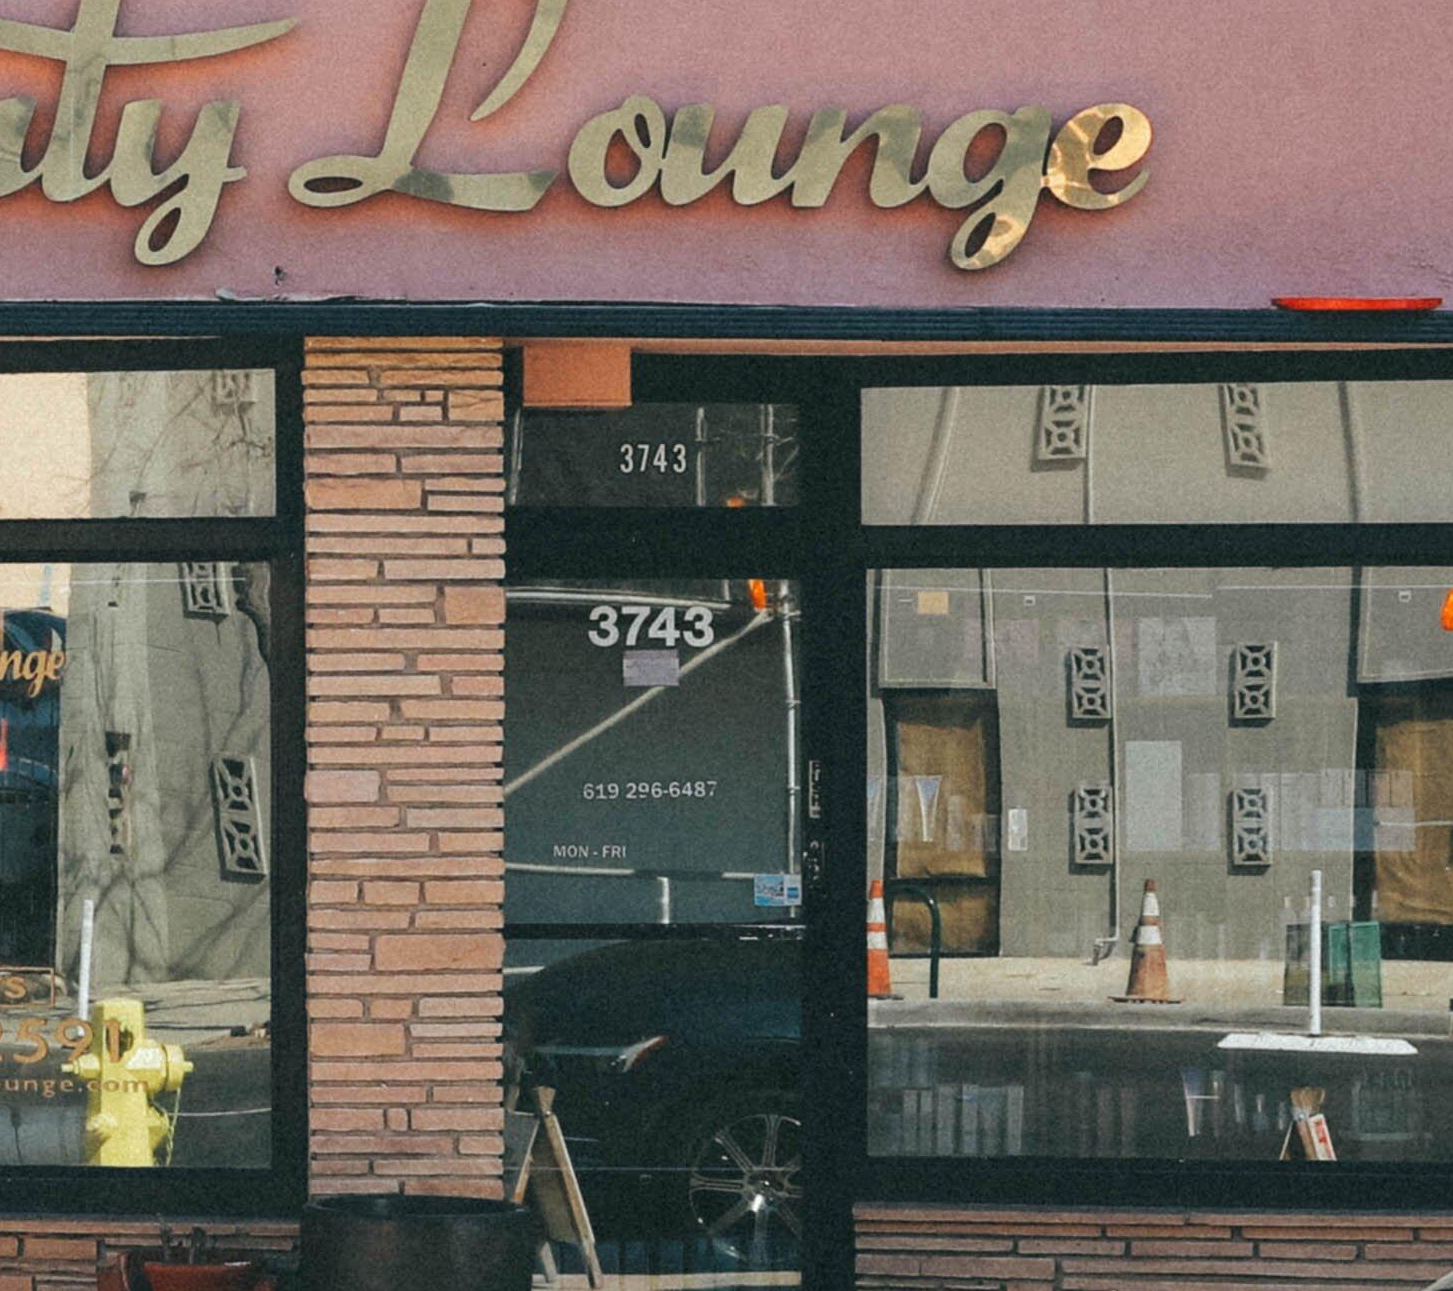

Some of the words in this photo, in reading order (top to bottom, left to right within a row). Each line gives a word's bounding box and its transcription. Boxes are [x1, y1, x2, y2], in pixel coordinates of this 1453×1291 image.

[619, 443, 688, 473] 3743
[587, 605, 715, 648] 3743
[582, 783, 620, 800] 619
[625, 781, 718, 799] 296-6487
[553, 845, 589, 858] MON
[602, 845, 627, 858] FRI
